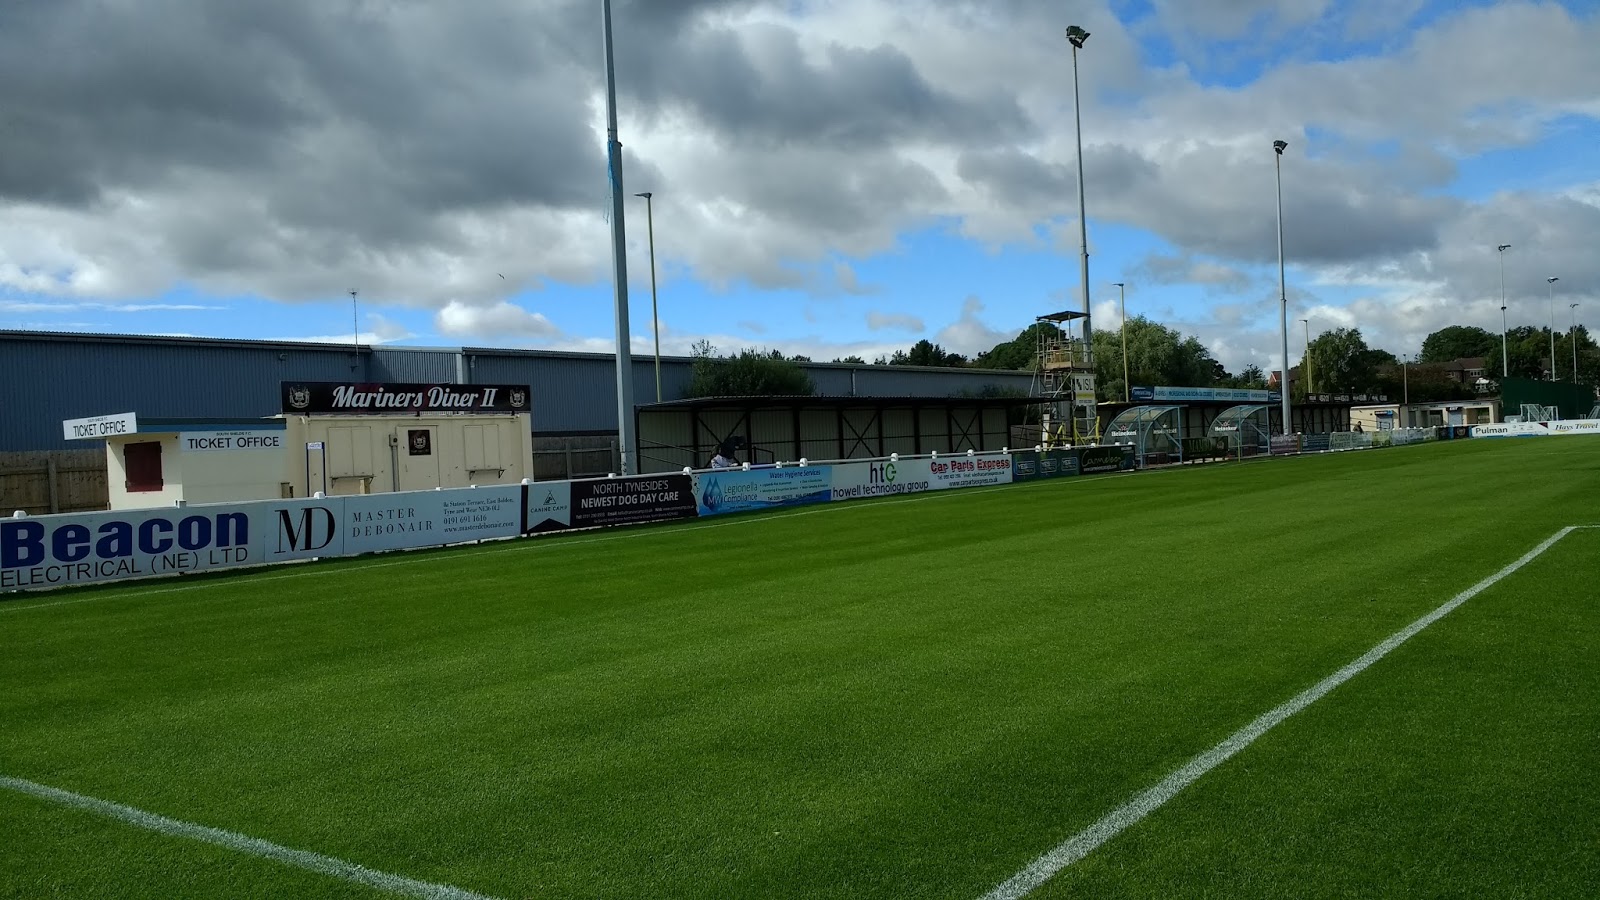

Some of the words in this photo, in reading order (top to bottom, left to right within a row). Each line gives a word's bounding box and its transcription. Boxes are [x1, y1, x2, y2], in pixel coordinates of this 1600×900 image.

[332, 385, 424, 408] Mariners
[427, 386, 479, 408] Diner
[479, 388, 499, 408] II
[73, 423, 97, 437] TICKET
[100, 420, 126, 435] OFFICE
[1475, 426, 1508, 434] Pulman
[1575, 422, 1599, 430] Travel
[187, 437, 231, 449] TICKET
[237, 436, 280, 448] OFFICE
[931, 462, 948, 474] Car
[951, 460, 974, 472] Parts
[977, 458, 1010, 471] Express
[785, 470, 803, 479] Hygiene
[803, 469, 821, 477] Services
[593, 483, 623, 495] NORTH
[625, 480, 669, 493] TYNESIDE'S
[724, 482, 758, 495] Legionella
[833, 484, 862, 498] howell
[863, 480, 906, 496] technology
[907, 480, 929, 492] group
[581, 496, 616, 509] NEWEST
[618, 494, 638, 506] DOG
[639, 492, 658, 504] DAY
[658, 491, 679, 502] CARE
[724, 493, 758, 503] Compliance
[352, 508, 416, 523] MASTER
[443, 516, 458, 525] 0191
[460, 515, 471, 524] 691
[473, 514, 487, 522] 1616
[274, 507, 336, 554] MD
[352, 520, 434, 538] DEBONAIR
[444, 521, 514, 533] www.masterdebonair.com
[1, 512, 248, 568] Beacon
[1, 558, 142, 588] ELECTRICAL
[151, 551, 199, 574] (NE)
[209, 547, 248, 566] LTD
